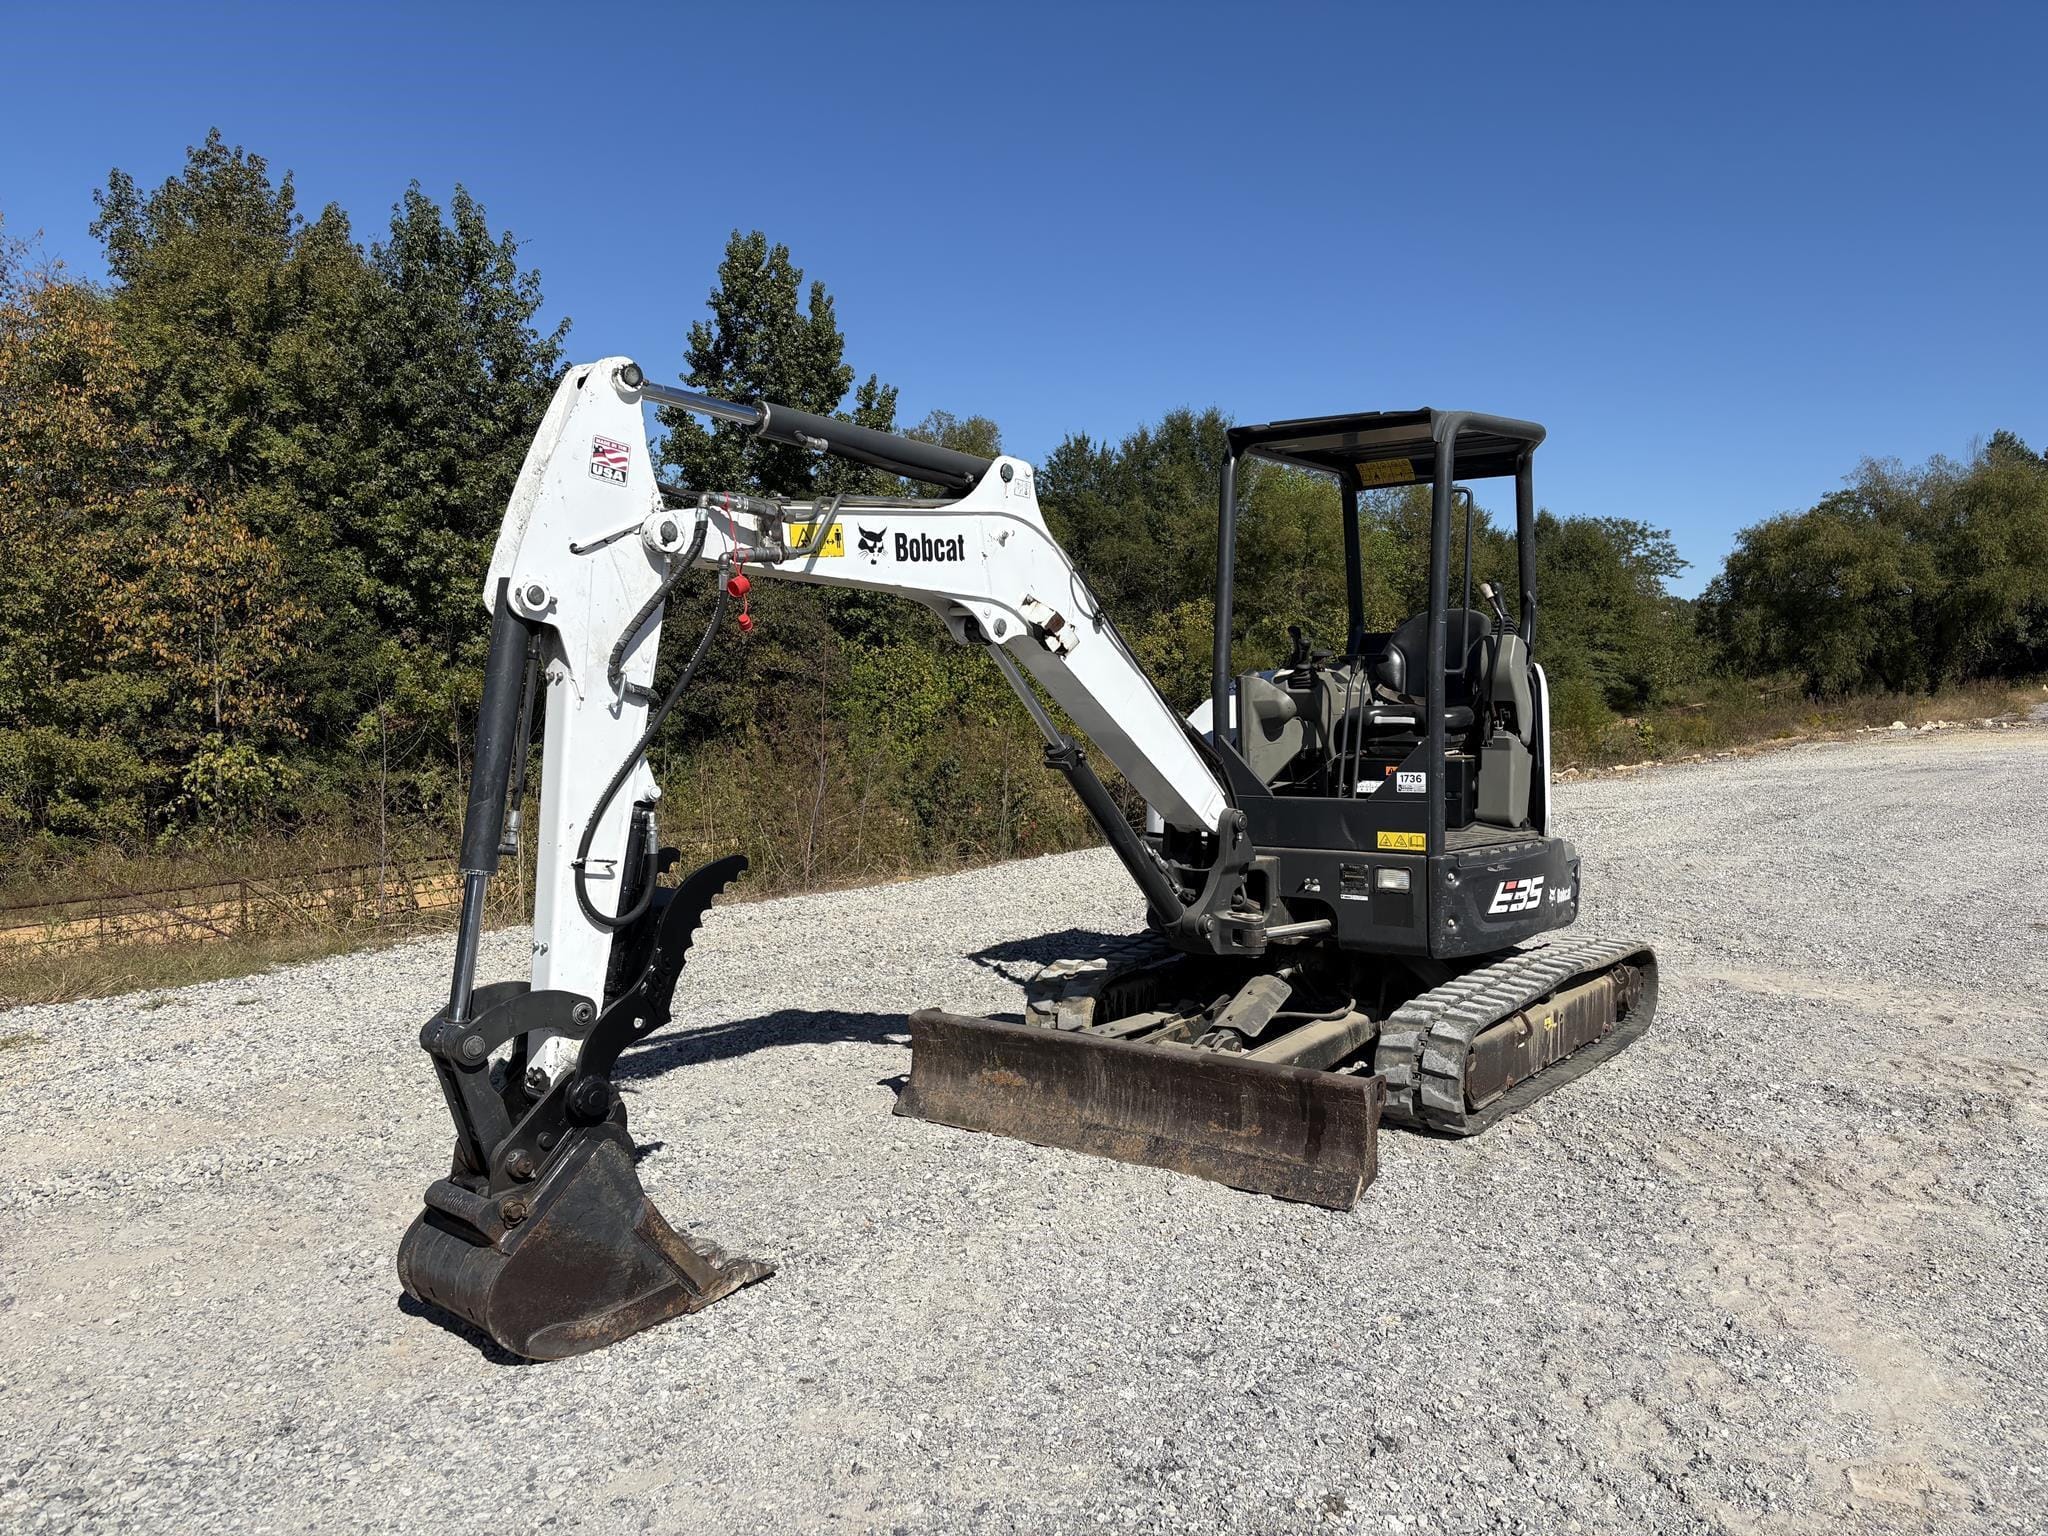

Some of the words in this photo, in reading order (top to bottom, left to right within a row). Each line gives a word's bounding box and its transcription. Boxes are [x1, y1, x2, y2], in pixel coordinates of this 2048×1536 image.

[592, 463, 624, 482] USA
[894, 532, 965, 562] Bobcat
[1400, 774, 1422, 783] 1736
[1487, 876, 1545, 914] E35
